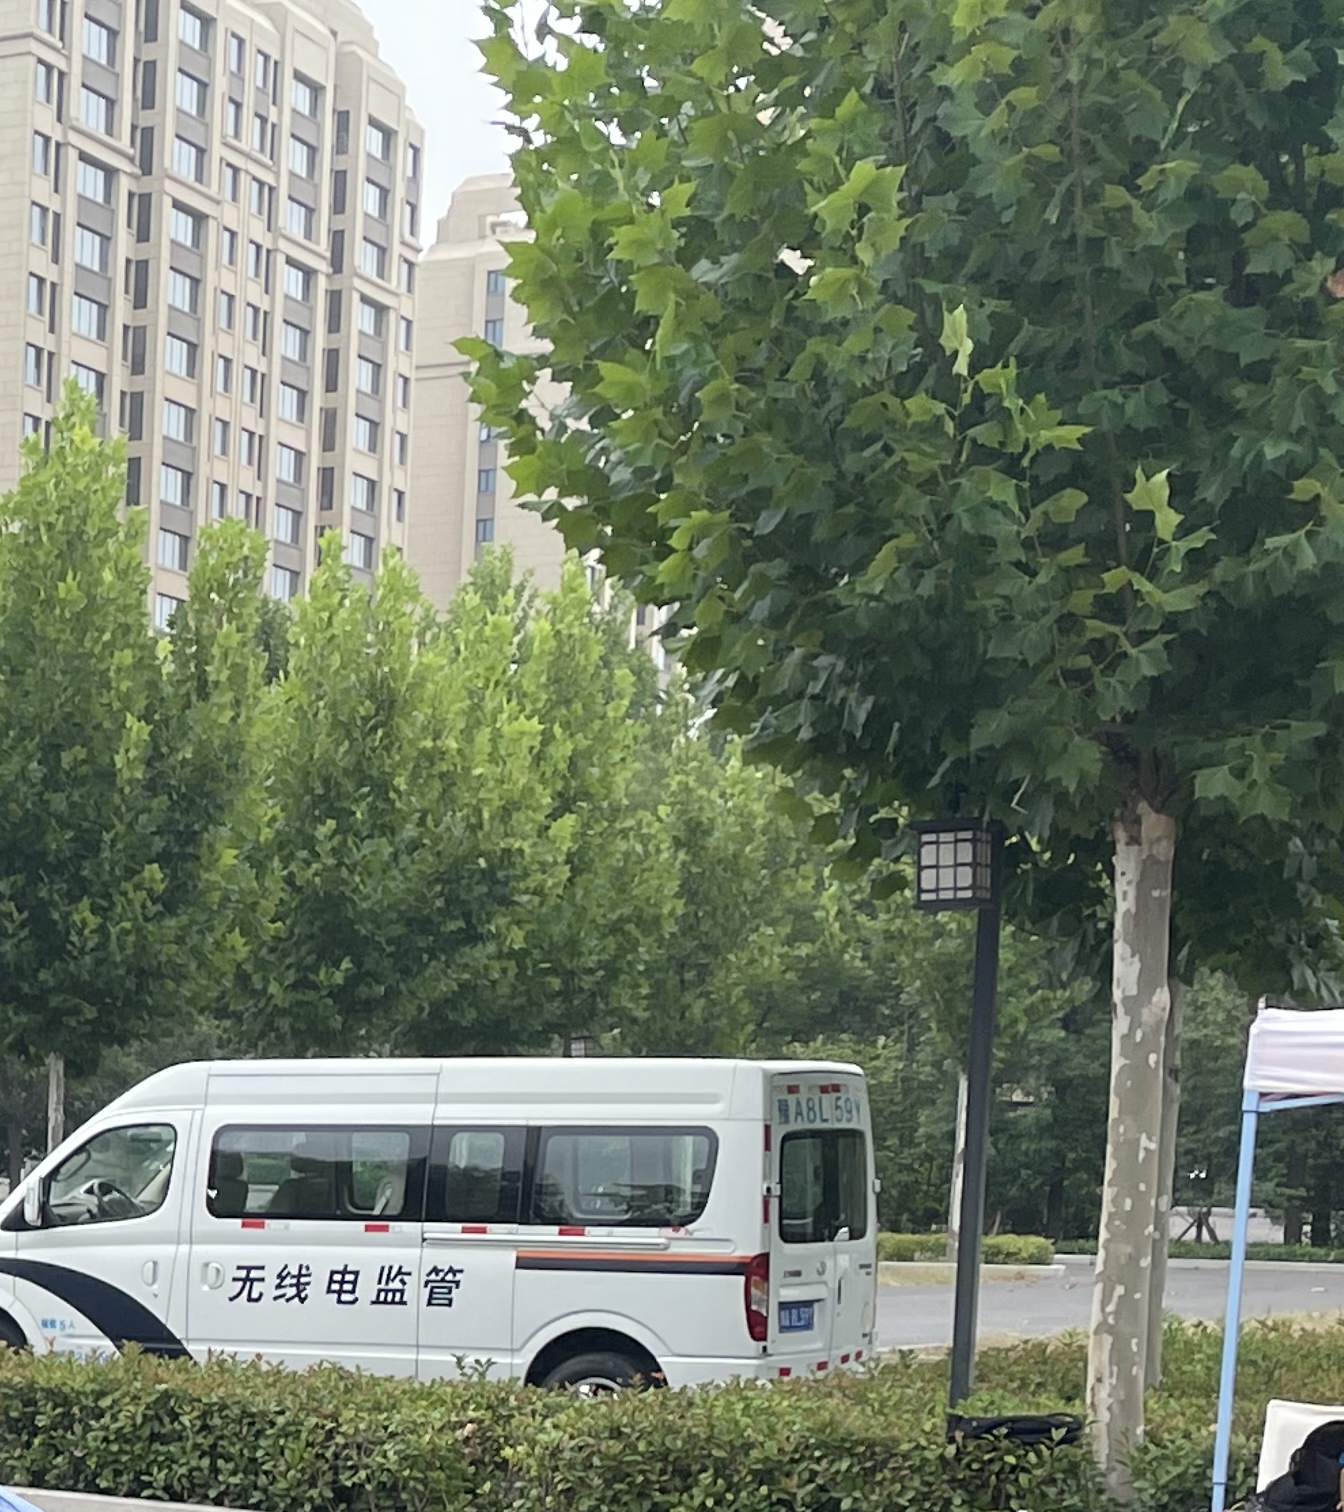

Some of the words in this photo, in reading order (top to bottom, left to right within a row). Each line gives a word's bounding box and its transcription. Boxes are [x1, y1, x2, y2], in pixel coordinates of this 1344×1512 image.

[228, 1263, 465, 1308] 无线电监管
